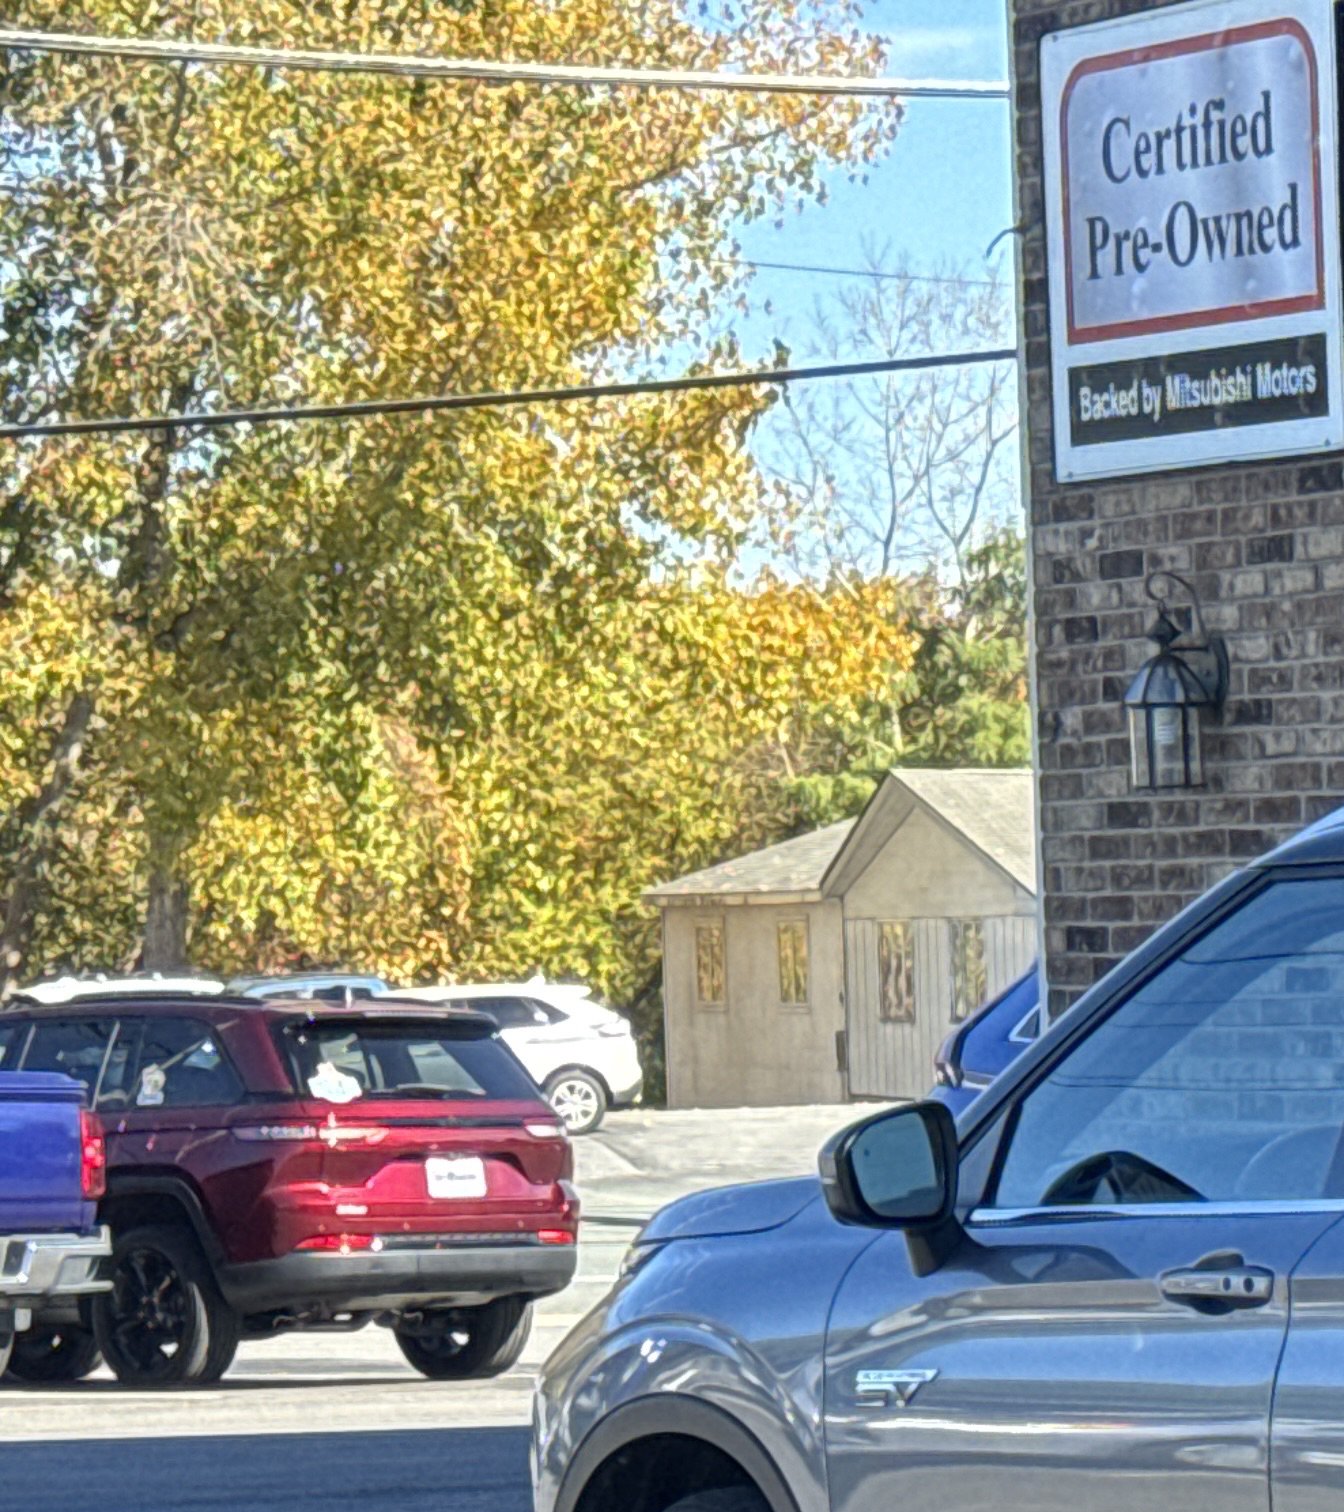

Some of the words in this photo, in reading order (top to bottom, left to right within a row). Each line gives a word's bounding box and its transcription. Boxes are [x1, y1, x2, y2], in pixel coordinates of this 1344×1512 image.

[1101, 90, 1275, 184] Certified
[1086, 182, 1302, 281] Pre-Owned
[1079, 379, 1139, 422] Backed
[1141, 376, 1162, 423] by
[1165, 365, 1253, 411] Mitsubishi
[1256, 361, 1317, 399] Motors
